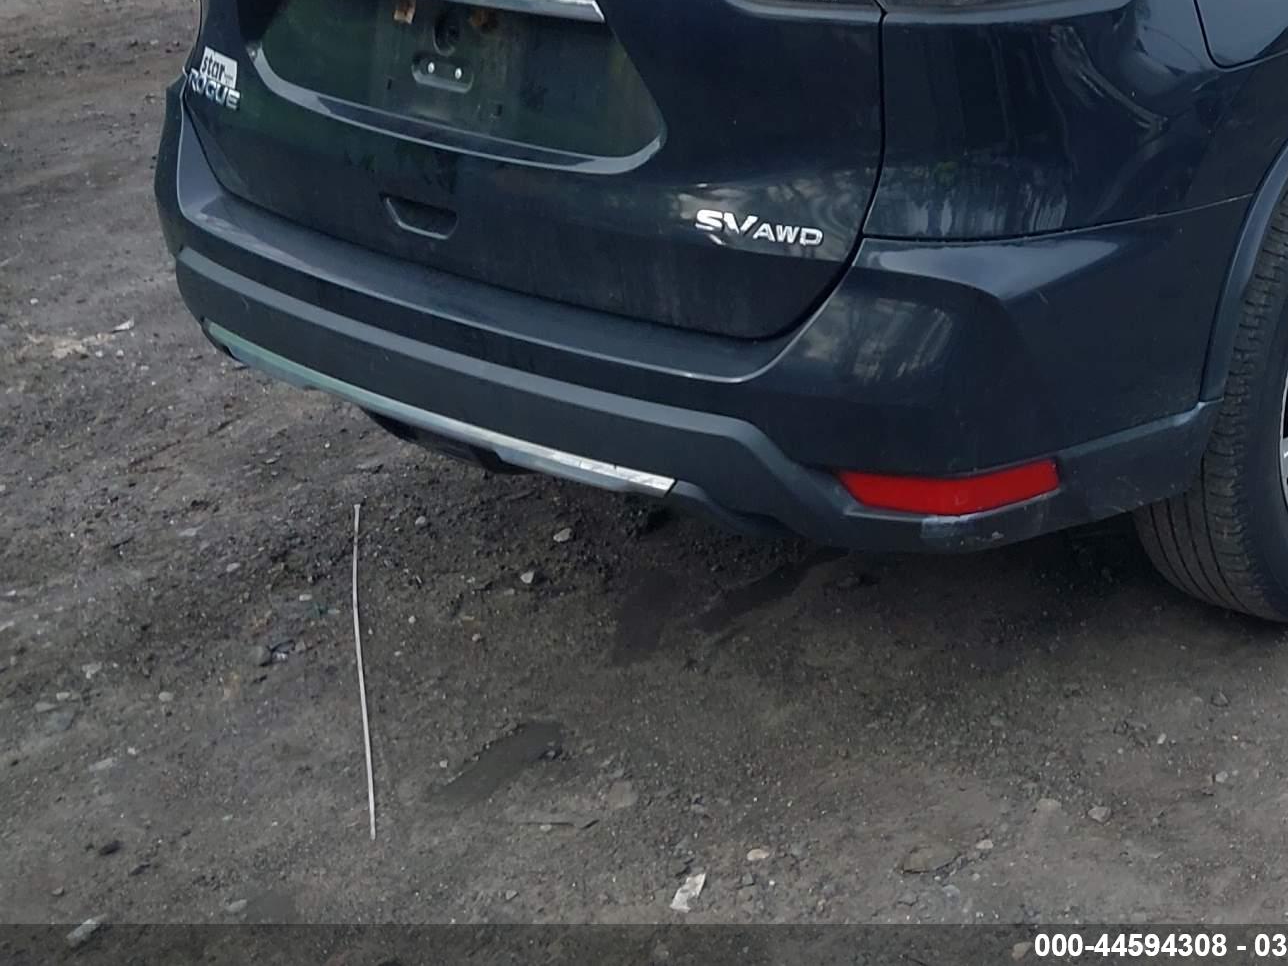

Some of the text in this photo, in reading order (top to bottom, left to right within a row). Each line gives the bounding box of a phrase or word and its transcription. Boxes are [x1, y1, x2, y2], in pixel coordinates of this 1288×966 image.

[202, 55, 226, 81] star
[189, 67, 240, 110] ROGUE
[695, 209, 823, 246] SV AWD
